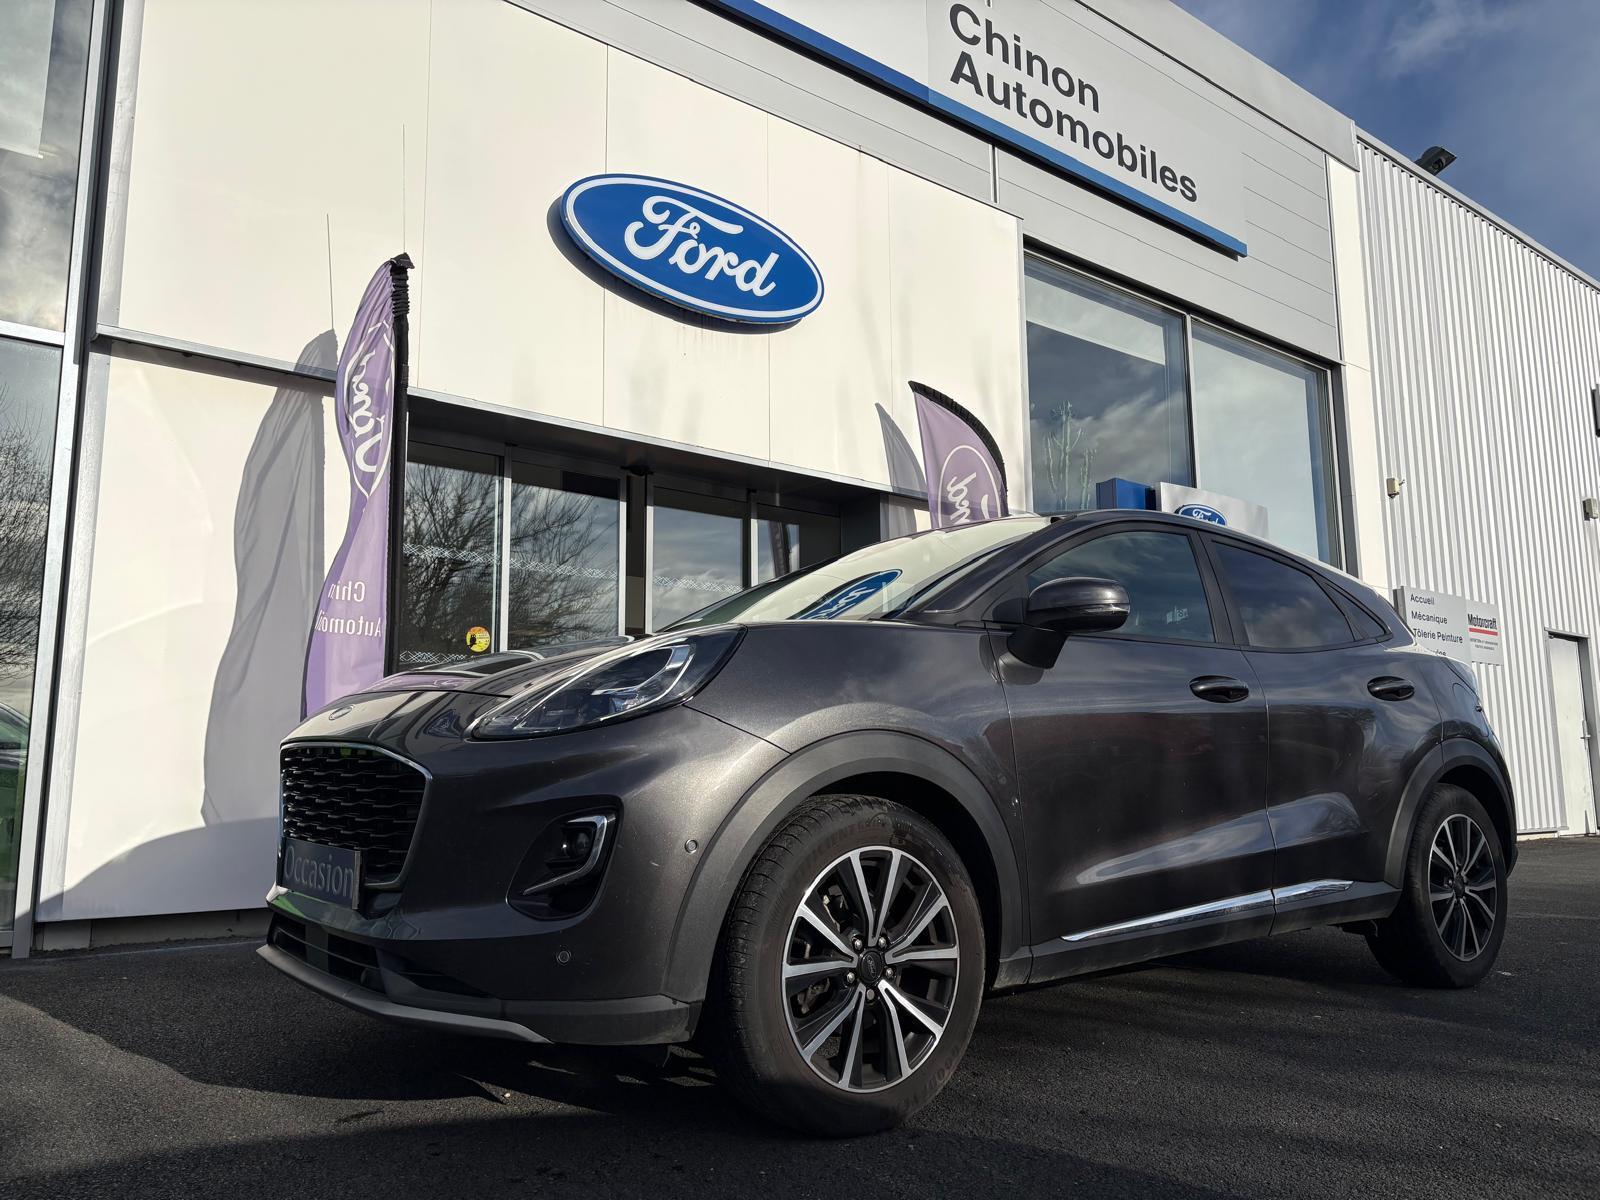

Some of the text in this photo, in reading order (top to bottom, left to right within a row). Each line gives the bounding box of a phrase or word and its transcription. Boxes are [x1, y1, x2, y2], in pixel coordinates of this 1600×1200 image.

[950, 3, 1100, 114] Chinon
[950, 50, 1198, 203] Automobiles
[624, 195, 780, 297] Ford
[1410, 593, 1435, 606] Accueil
[1411, 610, 1448, 625] Mécanique
[1467, 613, 1498, 629] Motorcraft
[1437, 631, 1463, 644] Peinture
[284, 845, 354, 900] Occasion
